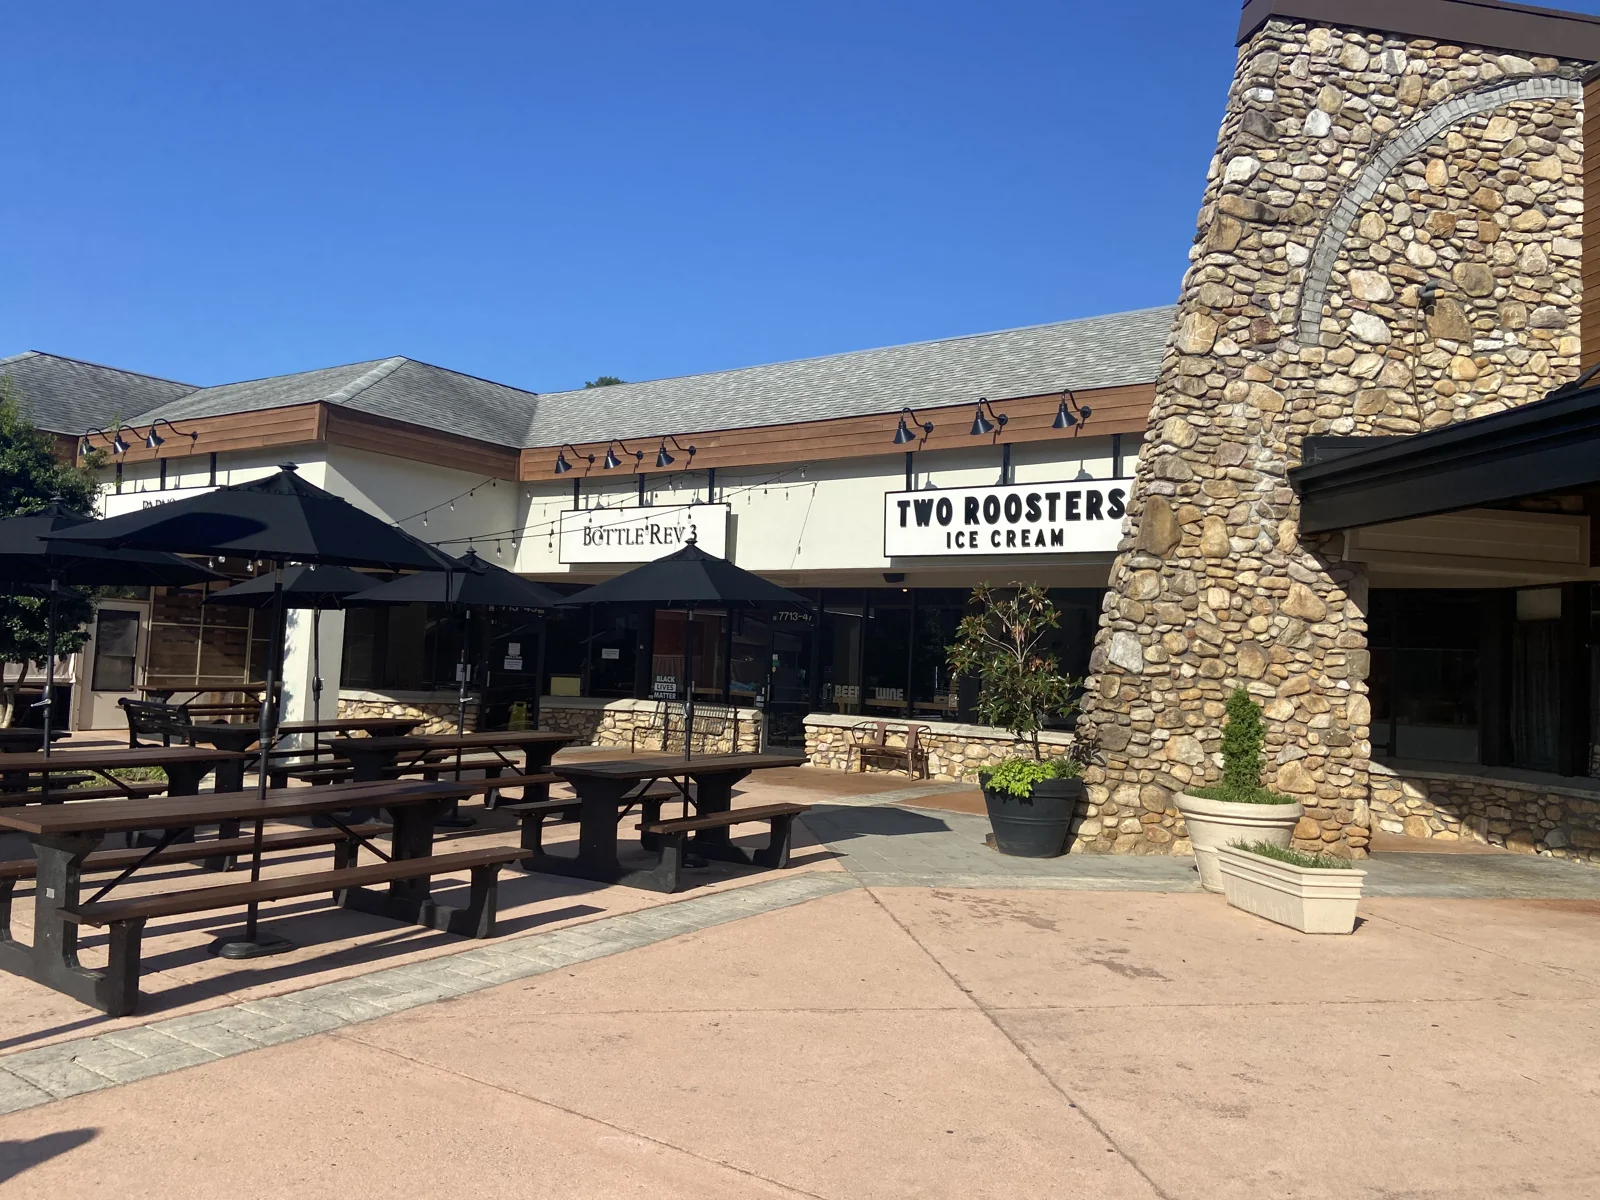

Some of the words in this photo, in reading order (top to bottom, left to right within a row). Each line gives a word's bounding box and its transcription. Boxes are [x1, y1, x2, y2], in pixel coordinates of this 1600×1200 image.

[897, 497, 953, 528] TWO
[964, 488, 1126, 526] ROOSTERS
[946, 531, 979, 549] ICE
[991, 528, 1064, 548] CREAM
[656, 675, 676, 683] BLACK
[654, 691, 677, 700] MATTER
[875, 687, 904, 701] WINE
